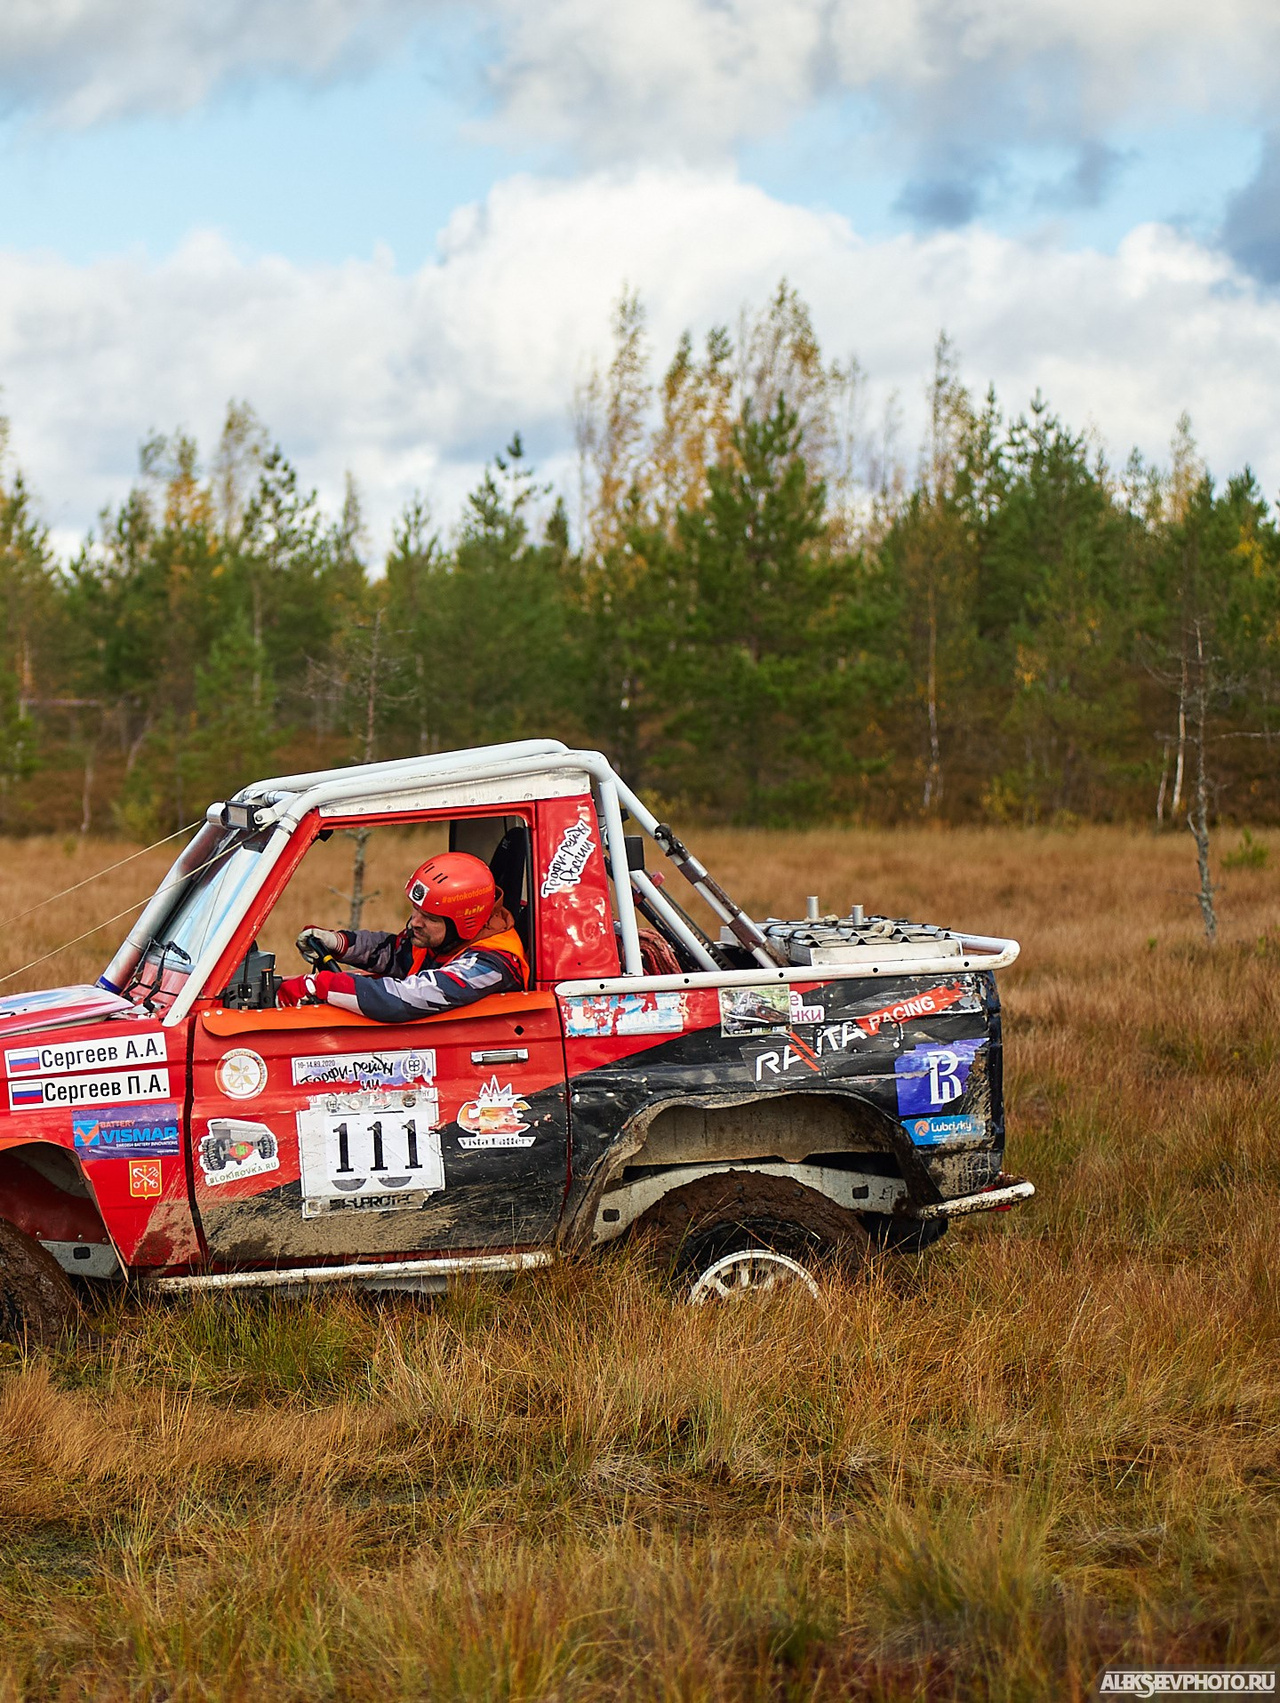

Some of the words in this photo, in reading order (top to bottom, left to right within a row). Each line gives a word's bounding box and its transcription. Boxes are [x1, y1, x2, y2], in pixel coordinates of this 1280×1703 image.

[869, 995, 936, 1032] RACING
[41, 1046, 118, 1070] Сергеев
[125, 1037, 165, 1059] А.А.
[44, 1081, 122, 1104] Сергеев
[127, 1073, 168, 1095] П.А.
[99, 1119, 136, 1129] BATTERY
[100, 1126, 178, 1144] VISMAR
[332, 1119, 423, 1174] 111
[460, 1138, 489, 1147] Vista
[491, 1137, 533, 1146] Battery
[208, 1161, 277, 1184] BLOKIROVKA.RU
